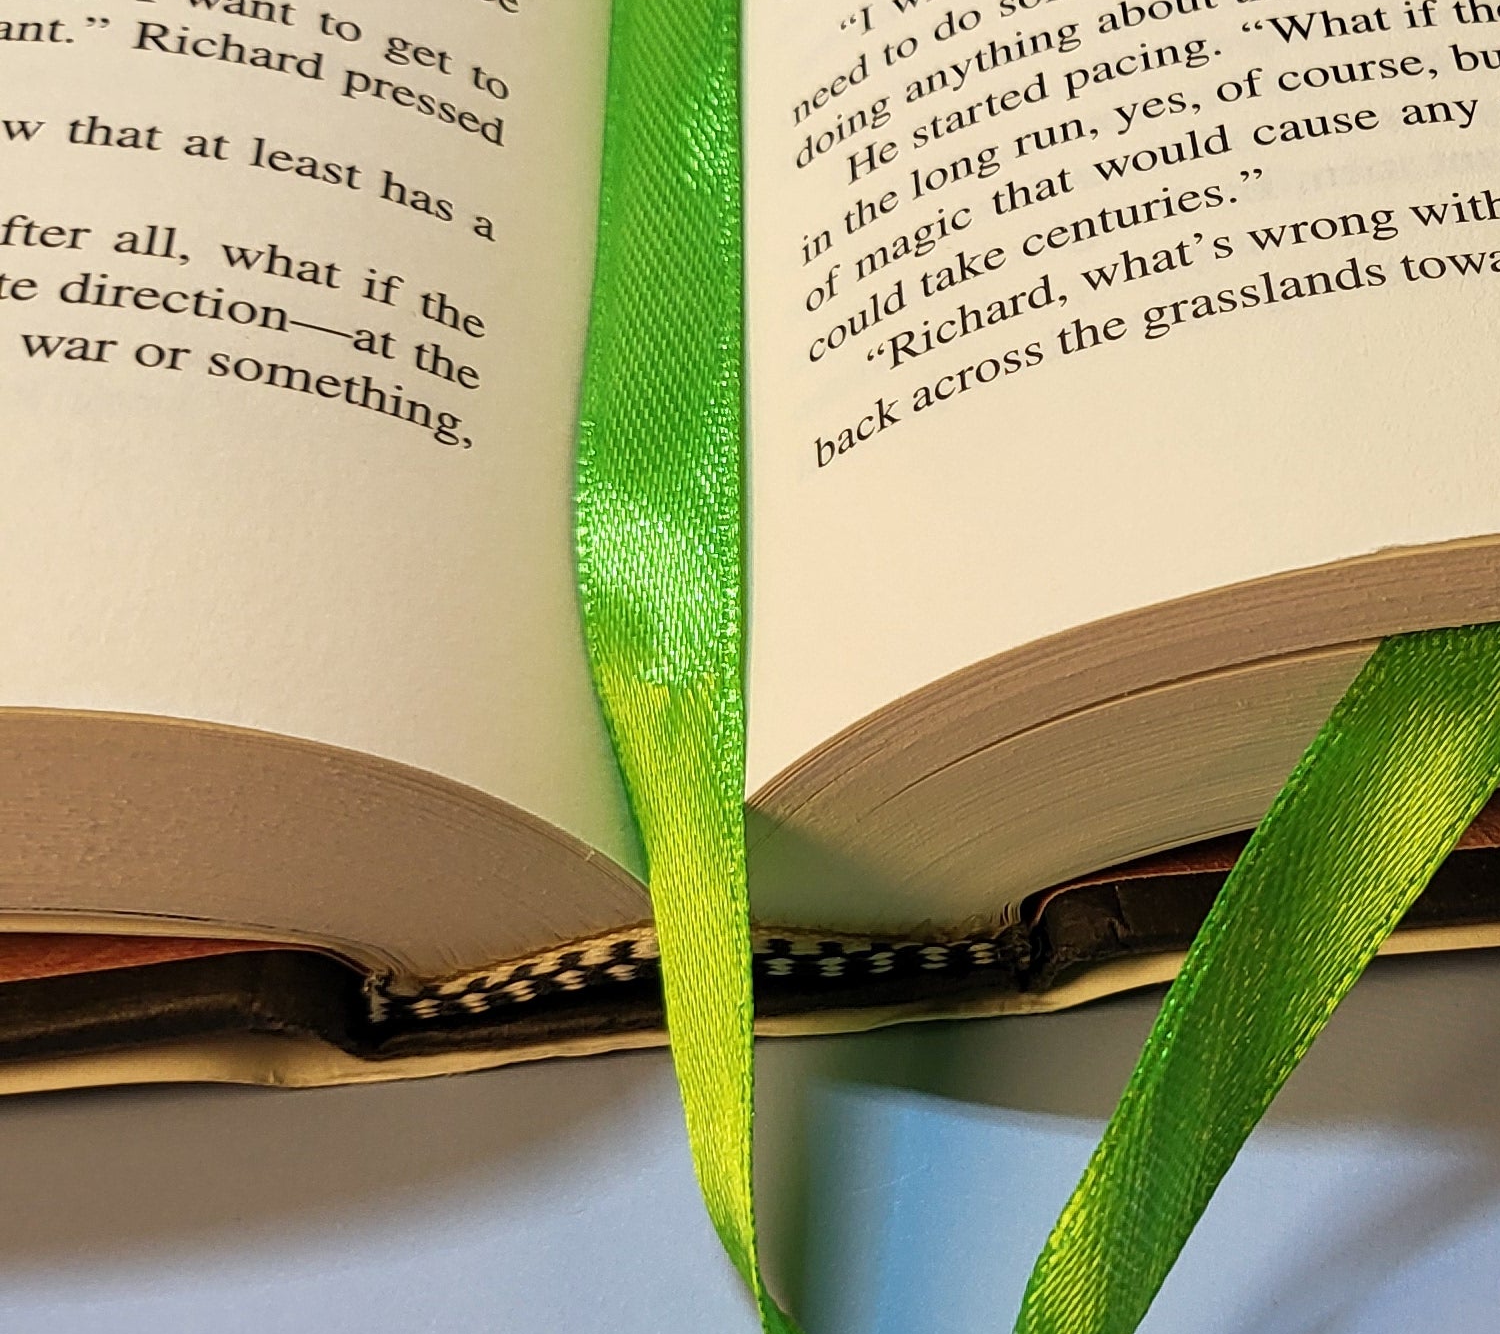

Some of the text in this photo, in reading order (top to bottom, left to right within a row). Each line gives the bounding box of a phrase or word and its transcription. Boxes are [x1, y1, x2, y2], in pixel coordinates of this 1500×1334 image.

[131, 21, 324, 81] Richard
[340, 69, 505, 148] pressed
[319, 12, 362, 42] to
[384, 36, 453, 75] get
[471, 66, 509, 100] to
[796, 96, 891, 170] doing
[906, 22, 1081, 104] anything
[846, 141, 899, 186] He
[913, 71, 1049, 150] started
[1064, 39, 1221, 102] pacing.
[68, 115, 496, 243] that at least has a
[802, 230, 833, 267] in
[844, 191, 899, 235] the
[910, 145, 1001, 201] long
[1014, 118, 1099, 159] run,
[1113, 91, 1201, 136] yes,
[1216, 67, 1263, 103] of
[1278, 56, 1438, 92] course,
[113, 224, 190, 266] all,
[220, 243, 341, 289] what
[362, 268, 405, 307] if
[420, 291, 485, 339] the
[1246, 209, 1399, 251] wrong
[809, 279, 907, 363] could
[920, 247, 1007, 298] take
[814, 397, 901, 469] back
[912, 341, 1044, 413] across
[1056, 317, 1127, 355] the
[1144, 257, 1387, 340] grasslands
[20, 334, 473, 450] war or something,
[414, 343, 480, 390] the
